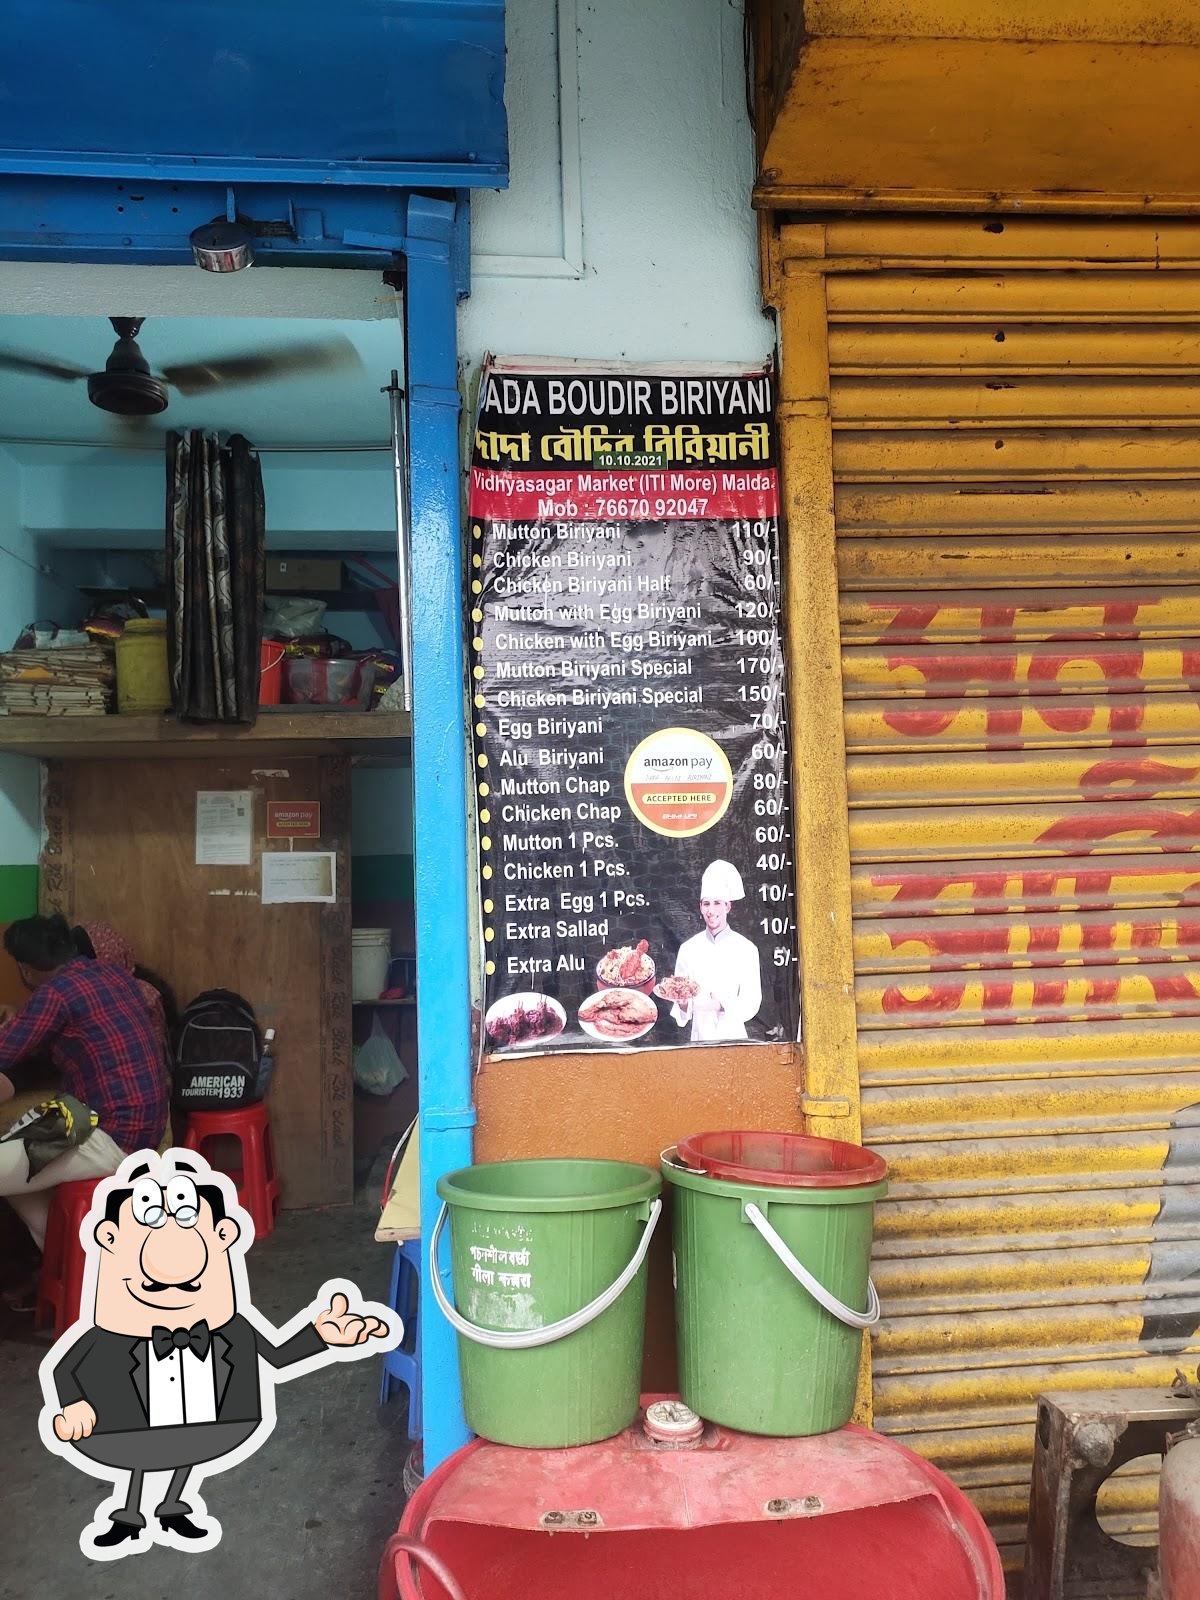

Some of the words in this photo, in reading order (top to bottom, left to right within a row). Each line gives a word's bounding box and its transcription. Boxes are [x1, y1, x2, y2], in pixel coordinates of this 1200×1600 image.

[548, 380, 651, 415] BOUDIR
[661, 378, 771, 415] BIRIYANI
[475, 430, 531, 461] দাদা
[598, 455, 663, 466] 10.10.2021
[474, 470, 573, 496] Vidhyasagar
[578, 474, 634, 492] Market
[639, 474, 665, 495] (ITI
[670, 474, 717, 495] More)
[537, 499, 579, 517] Mob
[595, 499, 649, 517] 76670
[655, 498, 709, 517] 92047
[492, 523, 551, 540] Mutton
[556, 522, 621, 542] Biriyani
[732, 521, 777, 538] 110/-
[493, 552, 562, 568] Chicken
[567, 550, 632, 570] Biriyani
[743, 549, 779, 566] 90/-
[493, 577, 562, 593] Chicken
[567, 575, 633, 595] Biriyani
[638, 574, 671, 592] Half
[744, 574, 780, 590] 60/-
[494, 605, 553, 621] Mutton
[558, 604, 594, 620] with
[600, 604, 632, 623] Egg
[638, 602, 701, 622] Biriyani
[735, 602, 781, 618] 120/-
[495, 634, 565, 650] Chicken
[569, 632, 605, 648] with
[611, 633, 643, 651] Egg
[649, 630, 712, 650] Biriyani
[736, 627, 782, 646] 100/-
[496, 662, 555, 678] Mutton
[561, 660, 626, 680] Biriyani
[631, 659, 692, 680] Special
[737, 657, 784, 674] 170/-
[498, 691, 567, 707] Chicken
[572, 689, 637, 709] Biriyani
[643, 687, 703, 708] Special
[738, 685, 785, 702] 150/-
[499, 719, 532, 739] Egg
[538, 717, 603, 738] Biriyani
[750, 713, 787, 730] 70/-
[500, 750, 528, 767] Alu
[539, 748, 604, 769] Biriyani
[751, 743, 788, 760] 60/-
[644, 758, 688, 767] amazon
[691, 757, 713, 769] pay
[501, 779, 560, 796] Mutton
[565, 776, 610, 797] Chap
[753, 773, 789, 790] 80/-
[690, 794, 712, 802] HERE
[274, 811, 299, 819] amazon
[502, 805, 573, 823] Chicken
[577, 803, 621, 822] Chap
[754, 798, 790, 815] 60/-
[503, 834, 562, 851] Mutton
[568, 834, 577, 849] 1
[583, 831, 619, 849] Pcs.
[755, 825, 791, 842] 60/-
[504, 863, 573, 880] Chicken
[579, 862, 588, 878] 1
[594, 861, 630, 877] Pcs.
[756, 853, 792, 871] 40/-
[505, 895, 550, 912] Extra
[560, 893, 593, 913] Egg
[599, 892, 608, 908] 1
[614, 890, 650, 907] Pcs.
[758, 884, 794, 902] 10/-
[506, 923, 551, 940] Extra
[556, 919, 609, 938] Sallad
[760, 917, 796, 935] 10/-
[507, 956, 552, 974] Extra
[556, 954, 585, 971] Alu
[773, 949, 798, 967] 5/-
[182, 1087, 218, 1097] TOURISTER
[218, 1086, 244, 1099] 1933
[190, 1075, 246, 1088] AMERICAN
